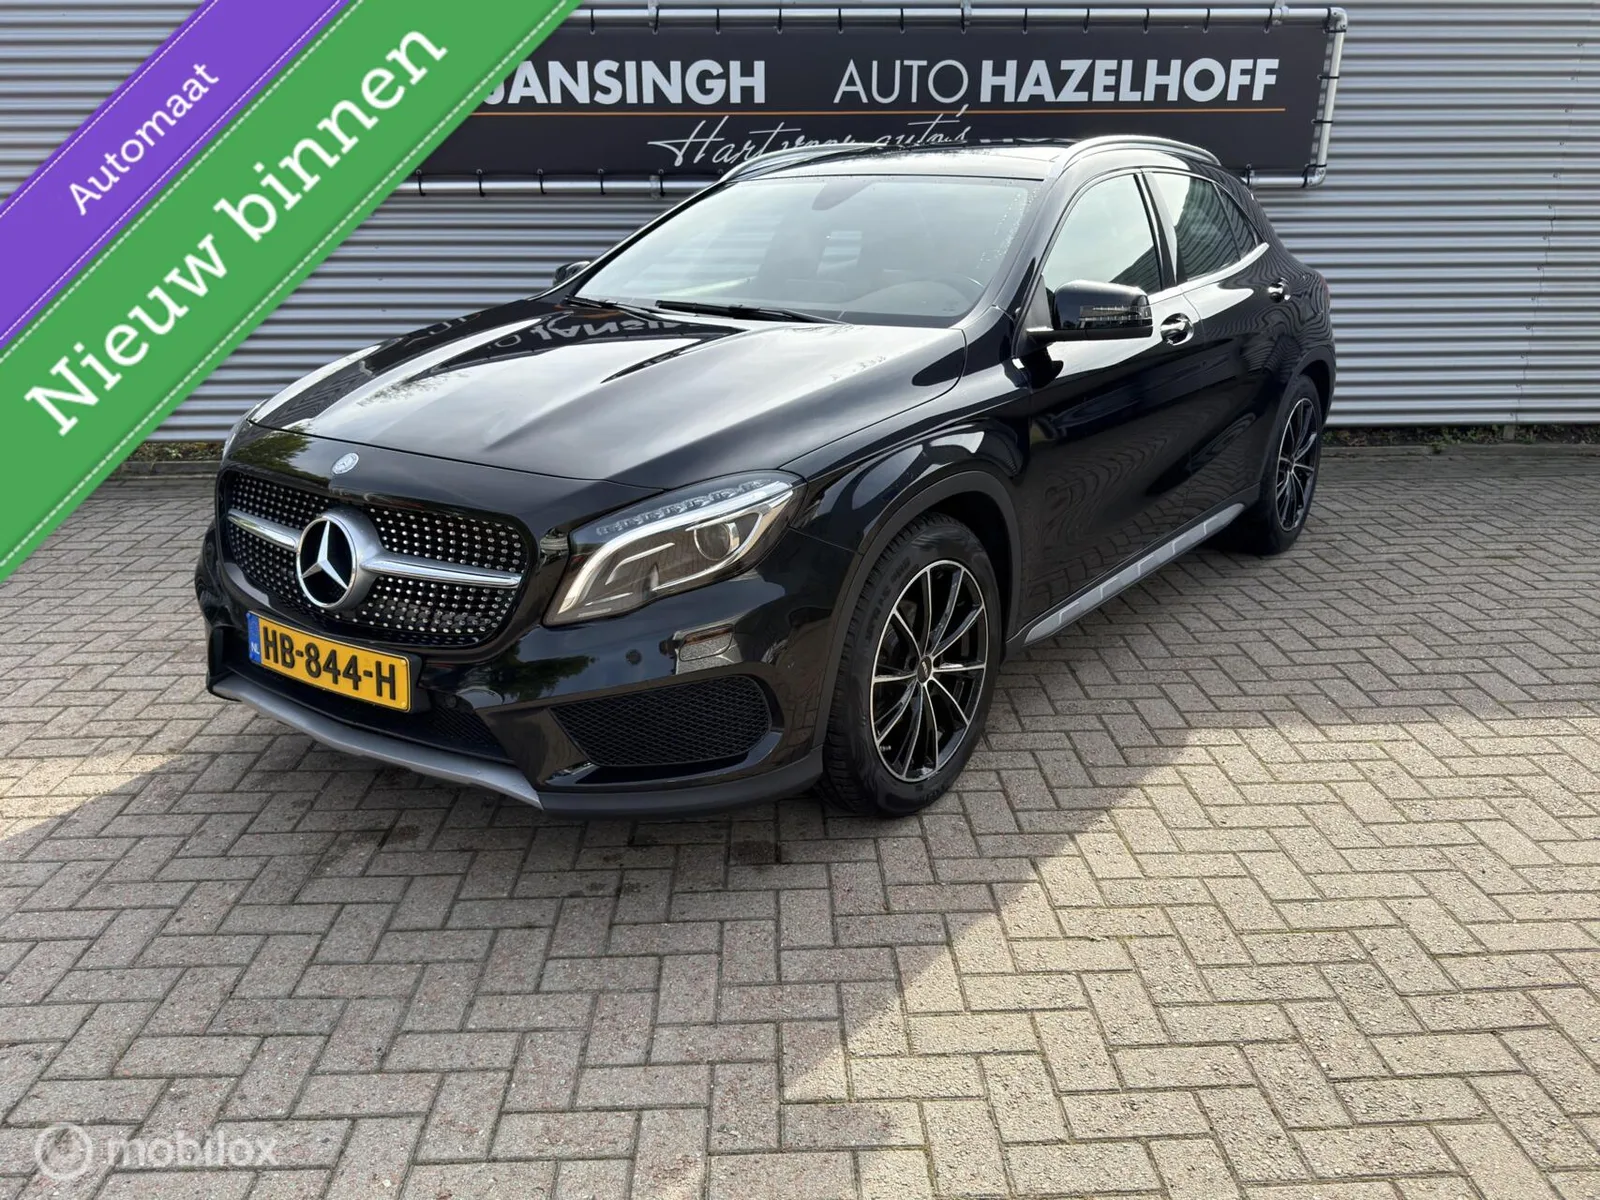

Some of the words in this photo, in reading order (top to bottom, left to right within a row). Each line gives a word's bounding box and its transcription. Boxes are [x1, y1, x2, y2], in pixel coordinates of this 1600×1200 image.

[833, 58, 970, 104] AUTO
[979, 57, 1280, 103] HAZELHOFF
[647, 115, 802, 167] Hart
[262, 625, 397, 701] HB-844-H
